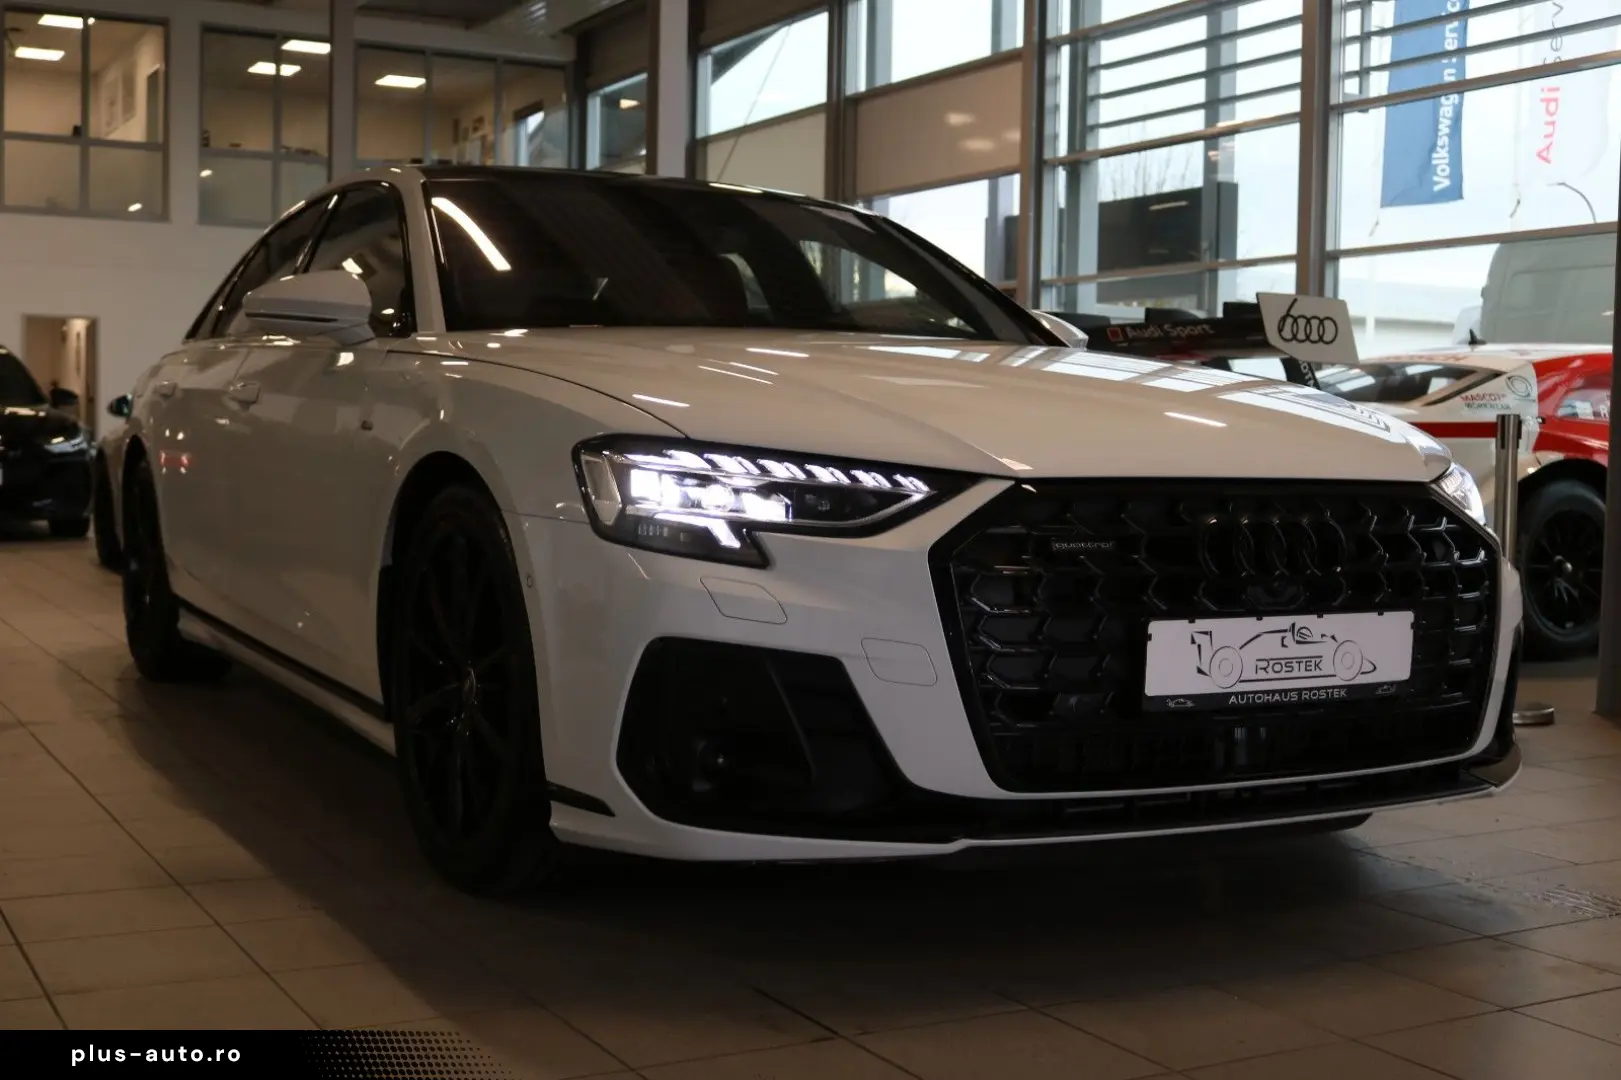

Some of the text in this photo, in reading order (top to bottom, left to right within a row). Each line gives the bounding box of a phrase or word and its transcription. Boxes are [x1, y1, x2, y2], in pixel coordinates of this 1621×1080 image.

[1432, 0, 1461, 192] Volkswagn ervc
[1535, 86, 1561, 165] Audi
[1126, 323, 1215, 339] Audi Sport
[1055, 540, 1111, 551] quattro
[1255, 658, 1323, 675] ROSTEK
[1229, 688, 1348, 705] AUTOHAUS ROSTEK
